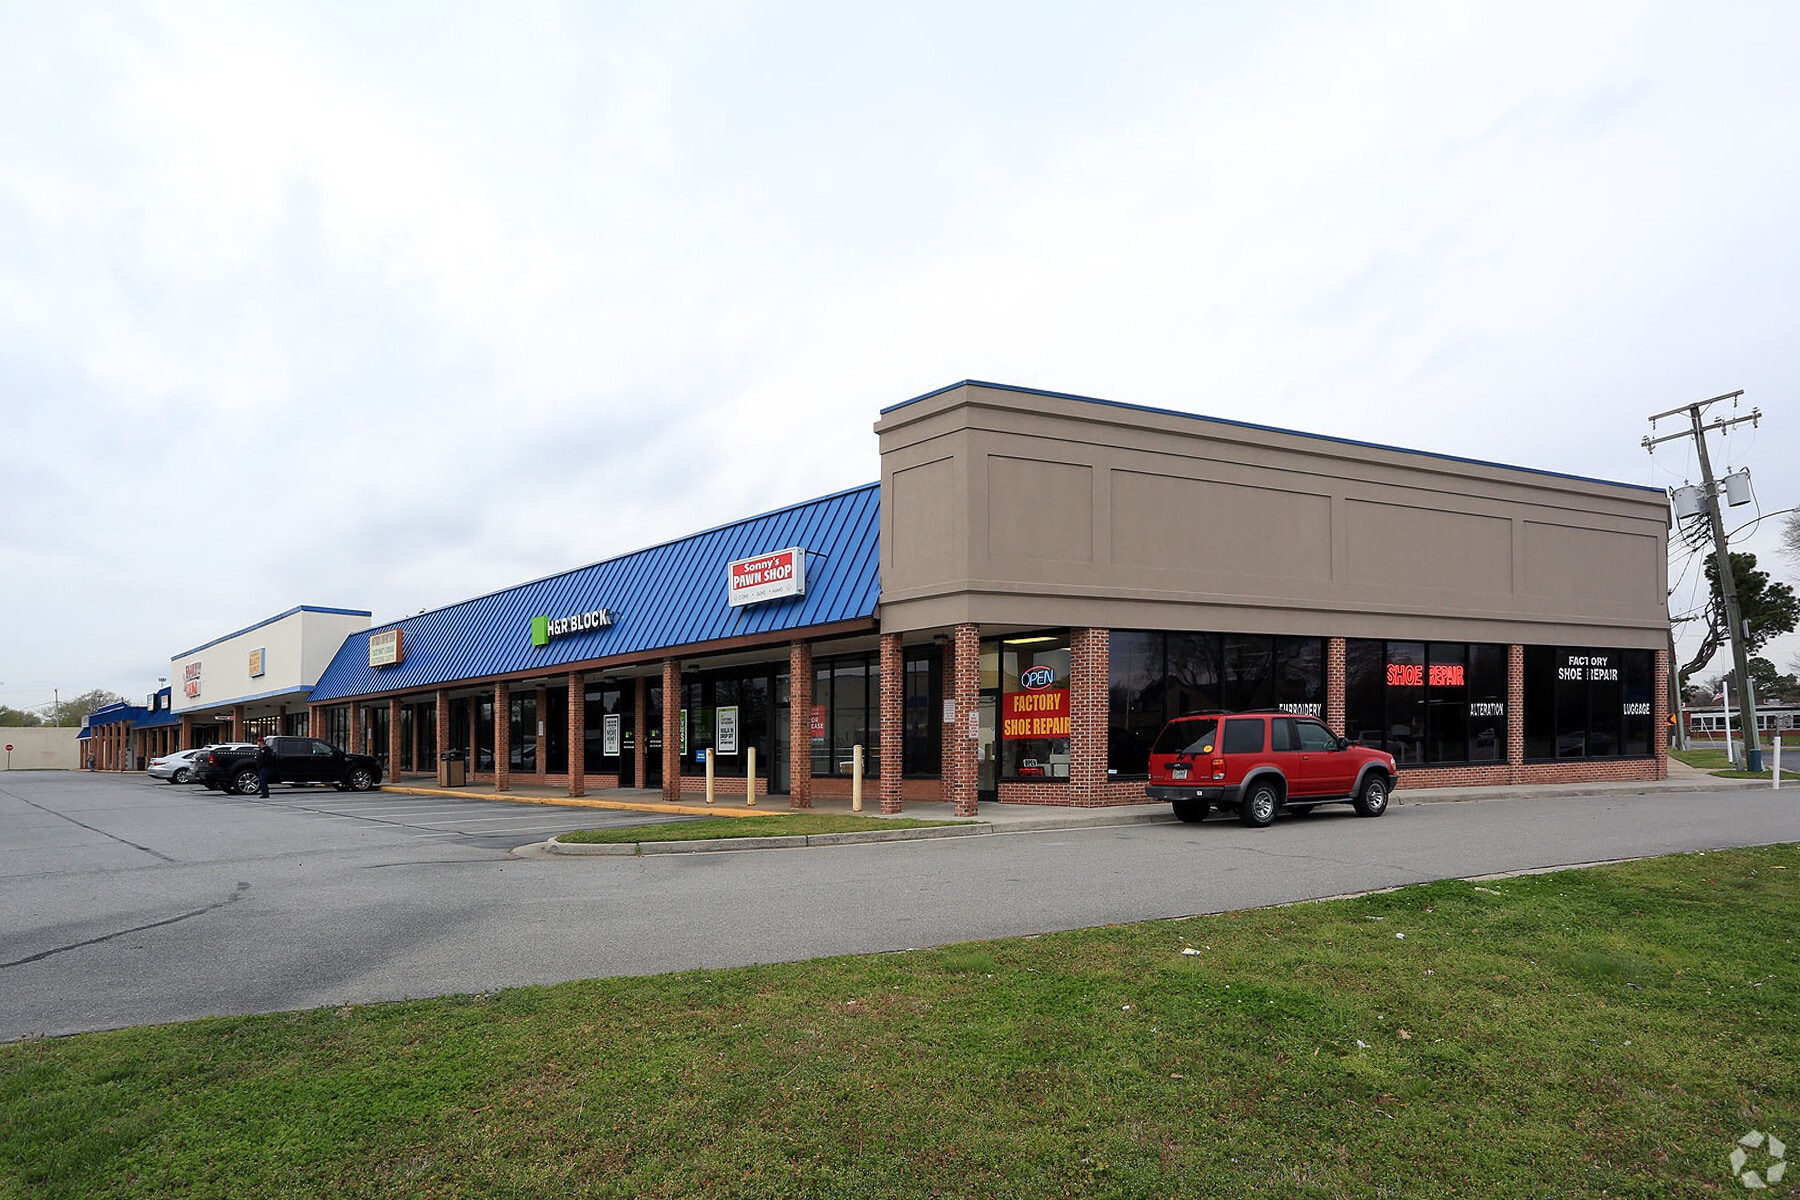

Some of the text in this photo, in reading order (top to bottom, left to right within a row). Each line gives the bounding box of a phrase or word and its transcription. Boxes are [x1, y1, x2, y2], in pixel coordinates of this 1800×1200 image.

[744, 557, 780, 573] Sonny's
[733, 564, 792, 589] PAWN SHOP
[547, 608, 612, 636] H&R BLOCK
[1568, 656, 1608, 666] FACTORY
[1021, 669, 1055, 687] OPEN
[1386, 663, 1465, 686] SHOE REPAIR
[1558, 667, 1618, 681] SHOE REPAIR
[1013, 693, 1061, 712] FACTORY
[1469, 703, 1504, 716] ALTERATION
[1623, 703, 1650, 715] LUGGAGE
[1004, 716, 1071, 736] SHOE REPAIR
[1018, 767, 1044, 777] OPEN
